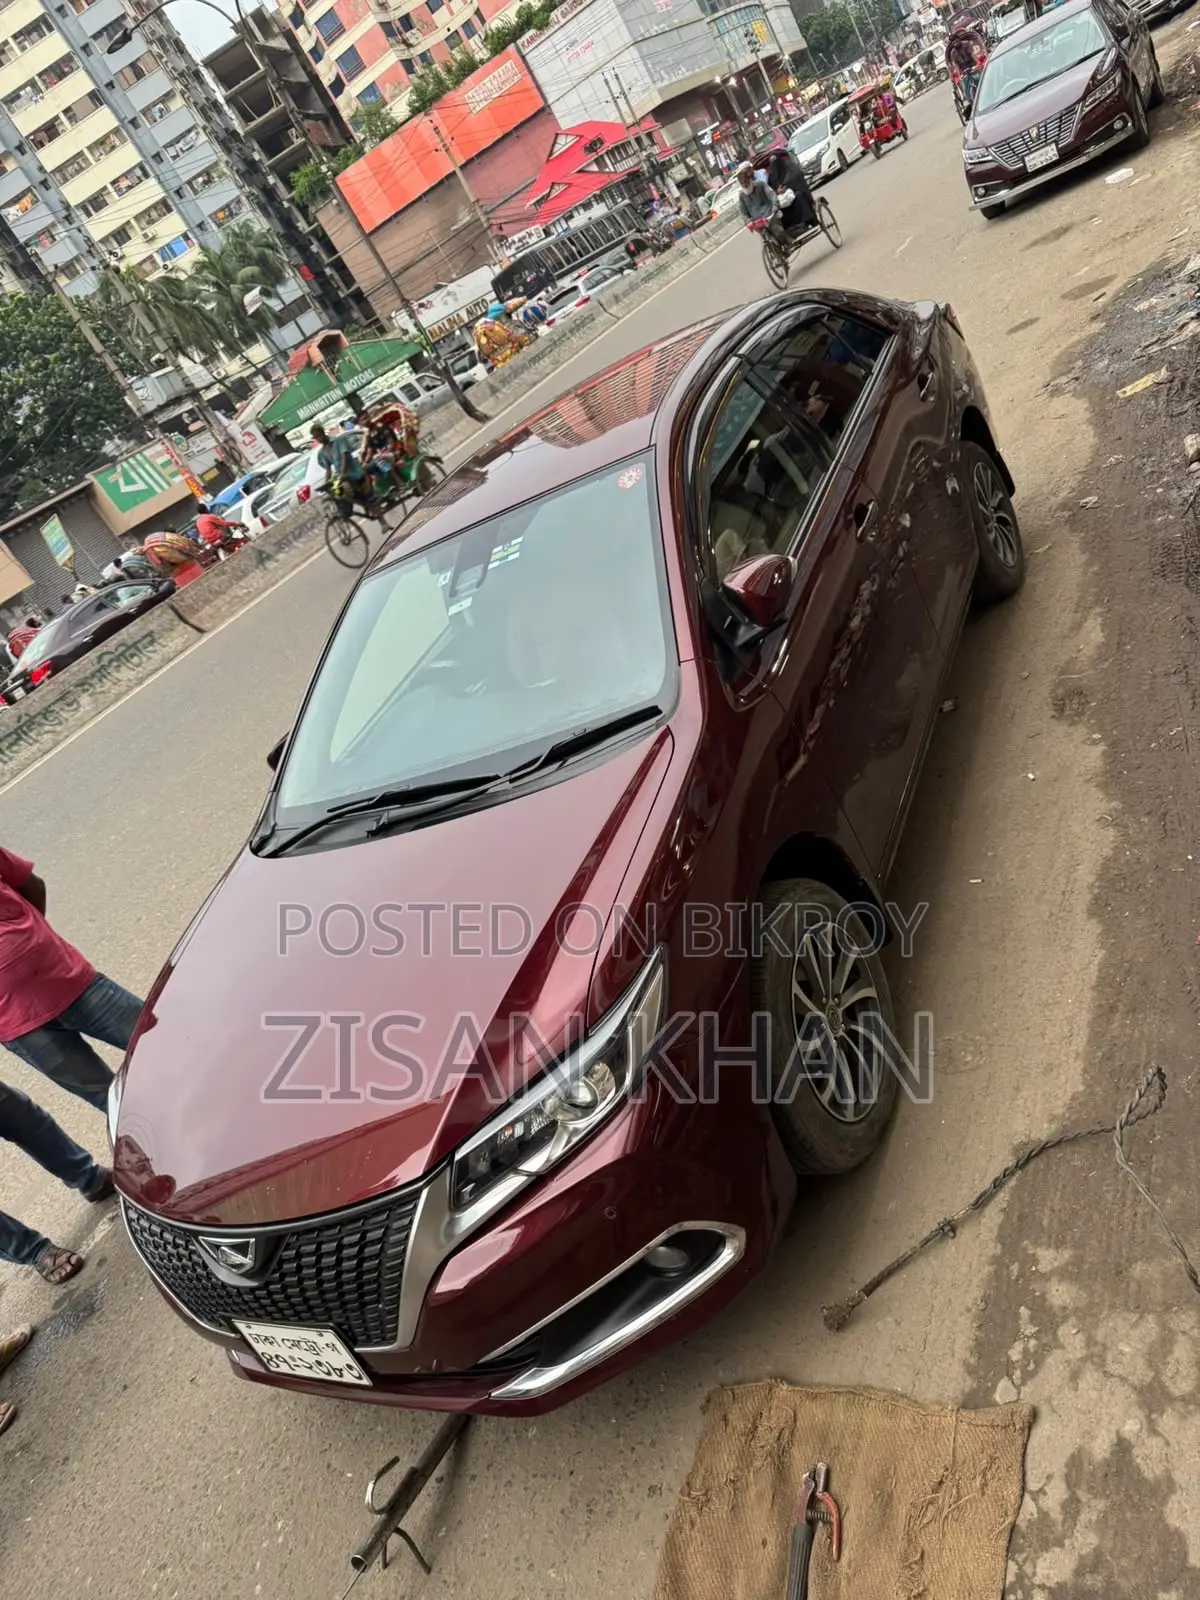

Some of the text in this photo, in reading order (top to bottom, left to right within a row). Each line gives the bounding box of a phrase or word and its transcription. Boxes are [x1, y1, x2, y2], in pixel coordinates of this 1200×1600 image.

[465, 298, 489, 320] AUTO
[297, 387, 342, 419] MANHATTAN
[343, 368, 375, 393] MOTORS
[249, 1332, 281, 1349] ঢাকা
